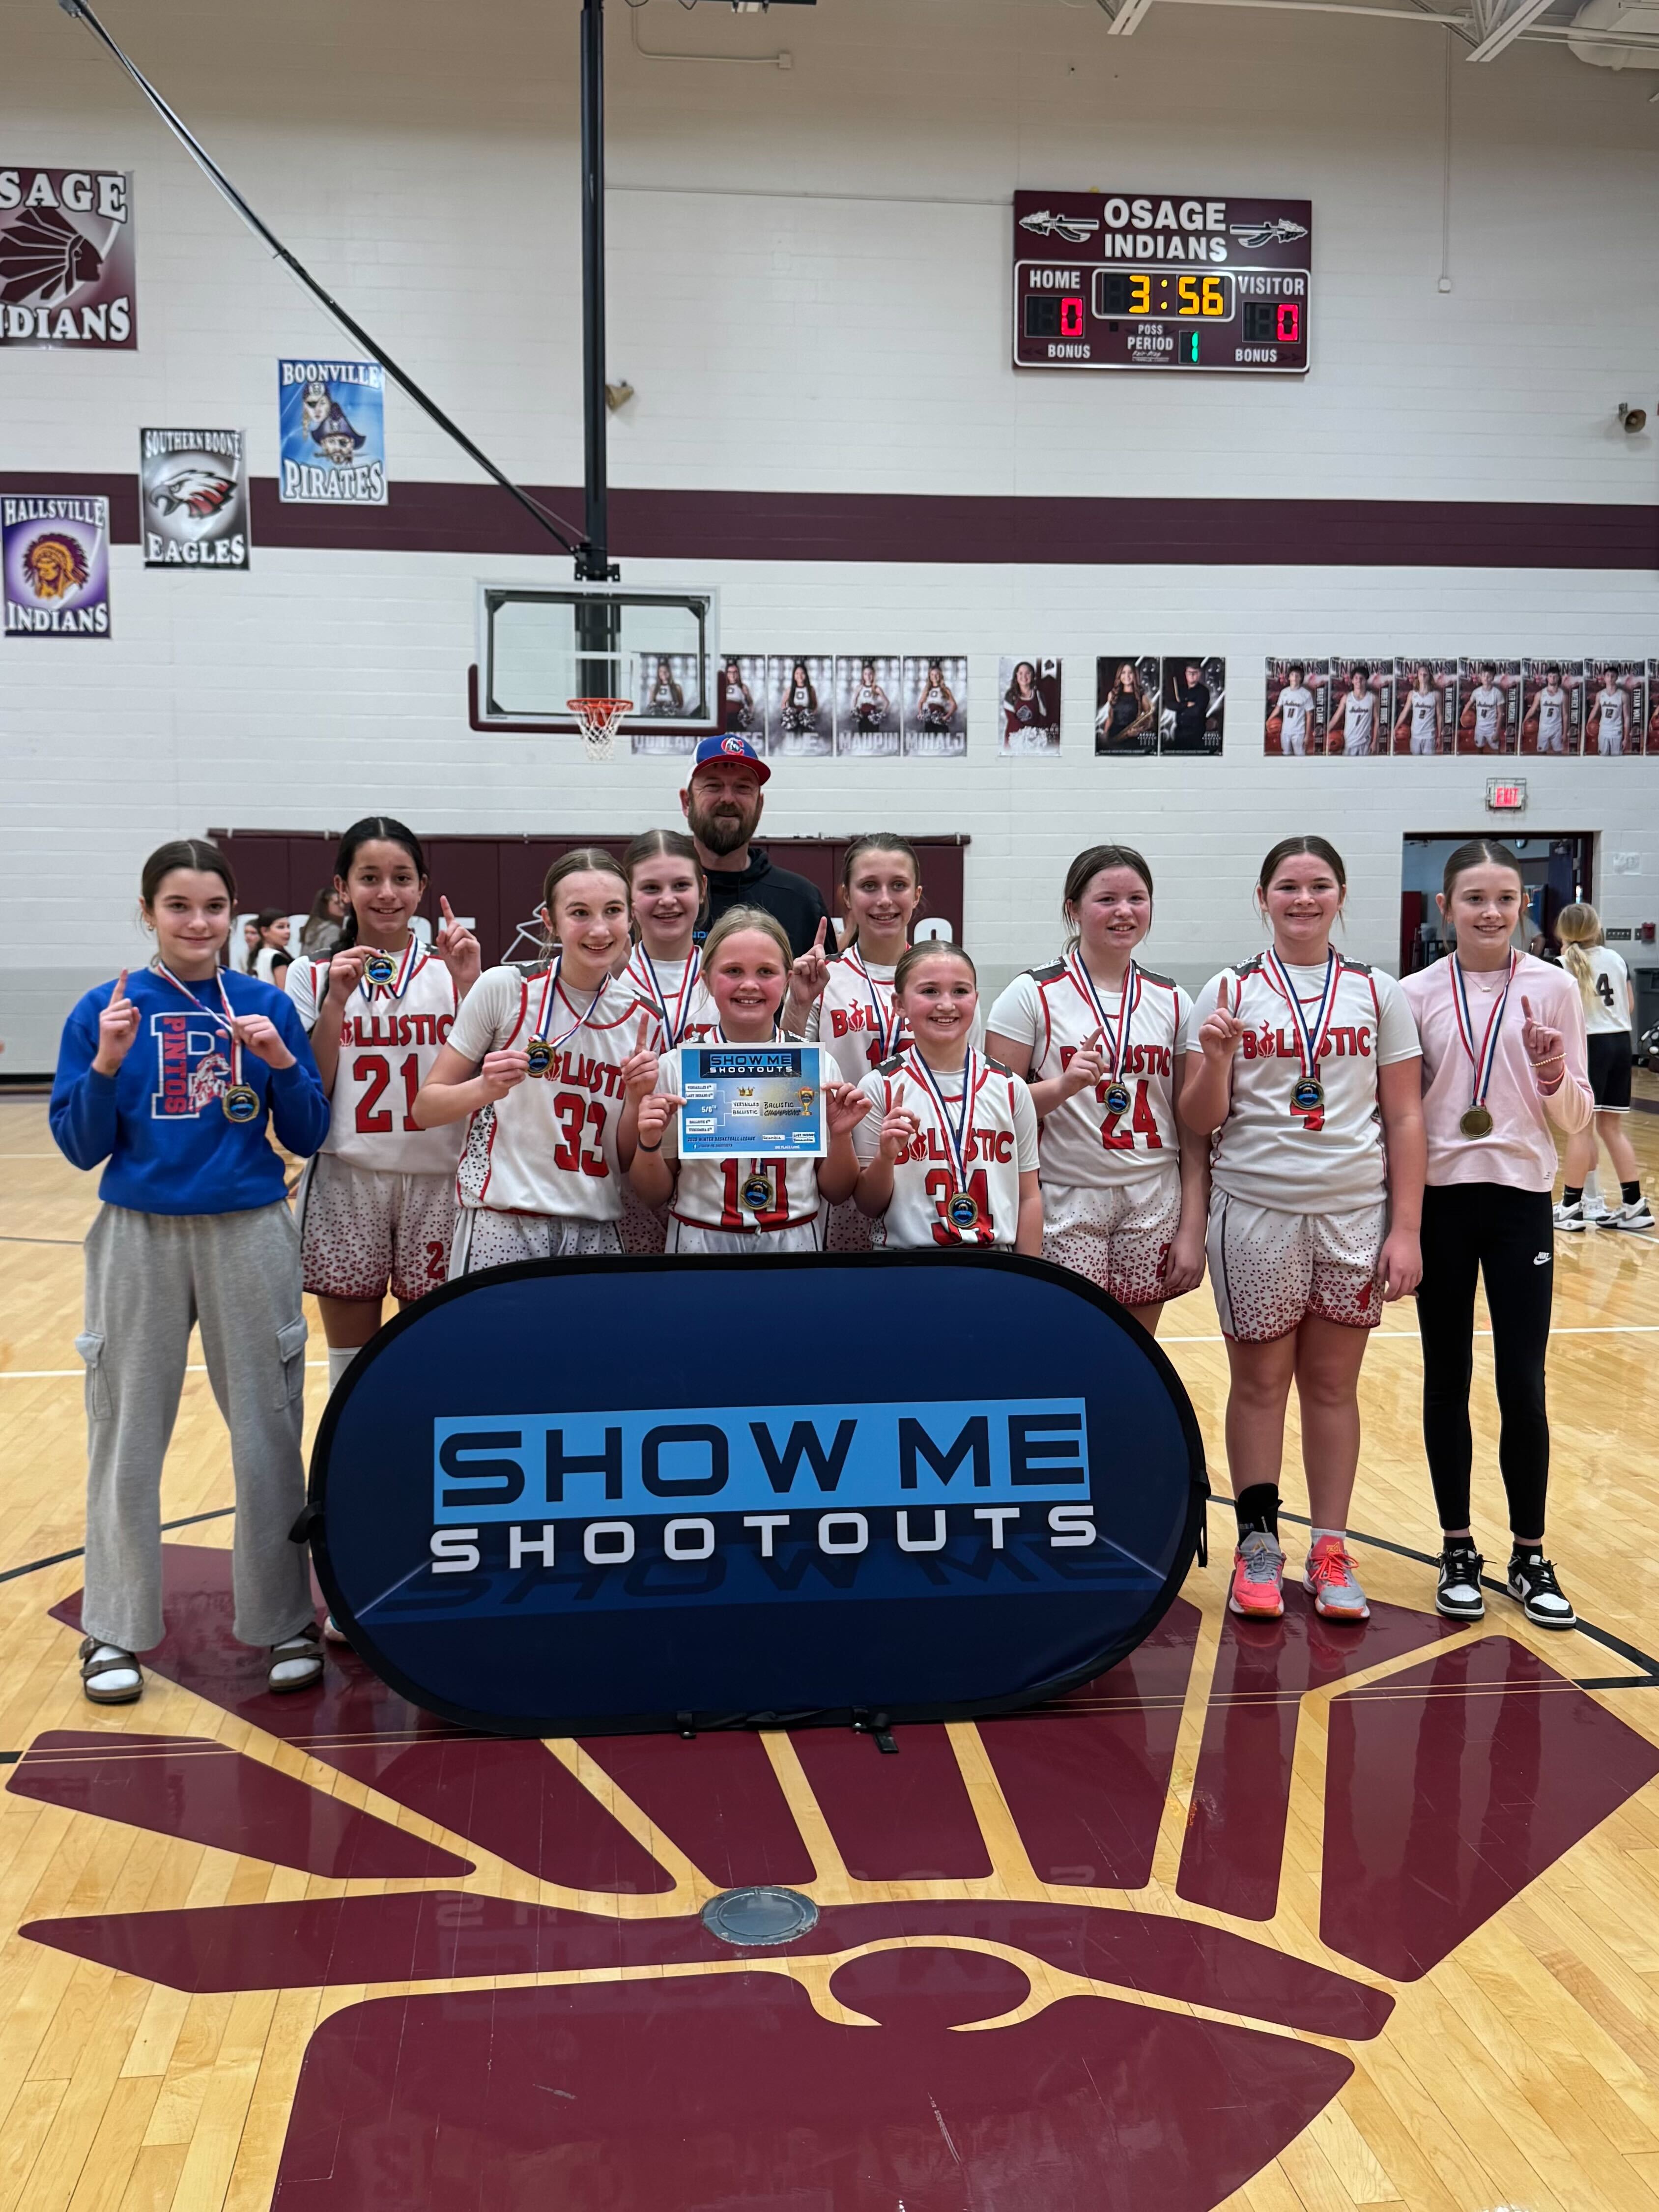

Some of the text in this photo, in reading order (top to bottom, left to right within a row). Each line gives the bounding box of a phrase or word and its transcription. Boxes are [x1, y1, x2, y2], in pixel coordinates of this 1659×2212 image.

[1104, 199, 1226, 231] OSAGE
[1104, 234, 1227, 261] INDIANS
[1030, 270, 1080, 289] HOME
[1129, 275, 1223, 315] 3:56
[1238, 276, 1304, 295] VISITOR
[1061, 297, 1082, 337] 0
[1138, 324, 1163, 335] POSS
[1277, 304, 1298, 342] 0
[1048, 345, 1090, 359] BONUS
[1127, 337, 1173, 350] PERIOD
[1192, 332, 1199, 362] 1
[1235, 348, 1277, 362] BONUS
[282, 362, 381, 388] BOONVILLE
[145, 431, 242, 460] SOUTHERN BOONE
[284, 460, 383, 502] PIRATES
[4, 498, 104, 528] HALLSVILLE
[148, 532, 245, 566] EAGLES
[8, 601, 108, 632] INDIANS
[839, 732, 898, 750] MAUPIN
[906, 732, 965, 750] MIHALJ
[1496, 788, 1518, 805] EXIT
[1596, 973, 1614, 1006] 4
[340, 1010, 454, 1047] ALLISTIC
[1242, 1019, 1371, 1059] BALLSTIC
[163, 1017, 187, 1113] PINTOS
[711, 1055, 792, 1065] SHOW ME
[1059, 1035, 1172, 1077] BISTIC
[353, 1053, 426, 1133] 21
[1095, 1080, 1163, 1149] 24
[554, 1092, 609, 1178] 33
[894, 1120, 1014, 1165] ALSTIC
[720, 1158, 789, 1227] 10
[925, 1169, 995, 1246] 34
[426, 1241, 445, 1279] 2
[439, 1413, 1087, 1507] SHOW ME
[430, 1505, 1096, 1574] SHOOTOUTS
